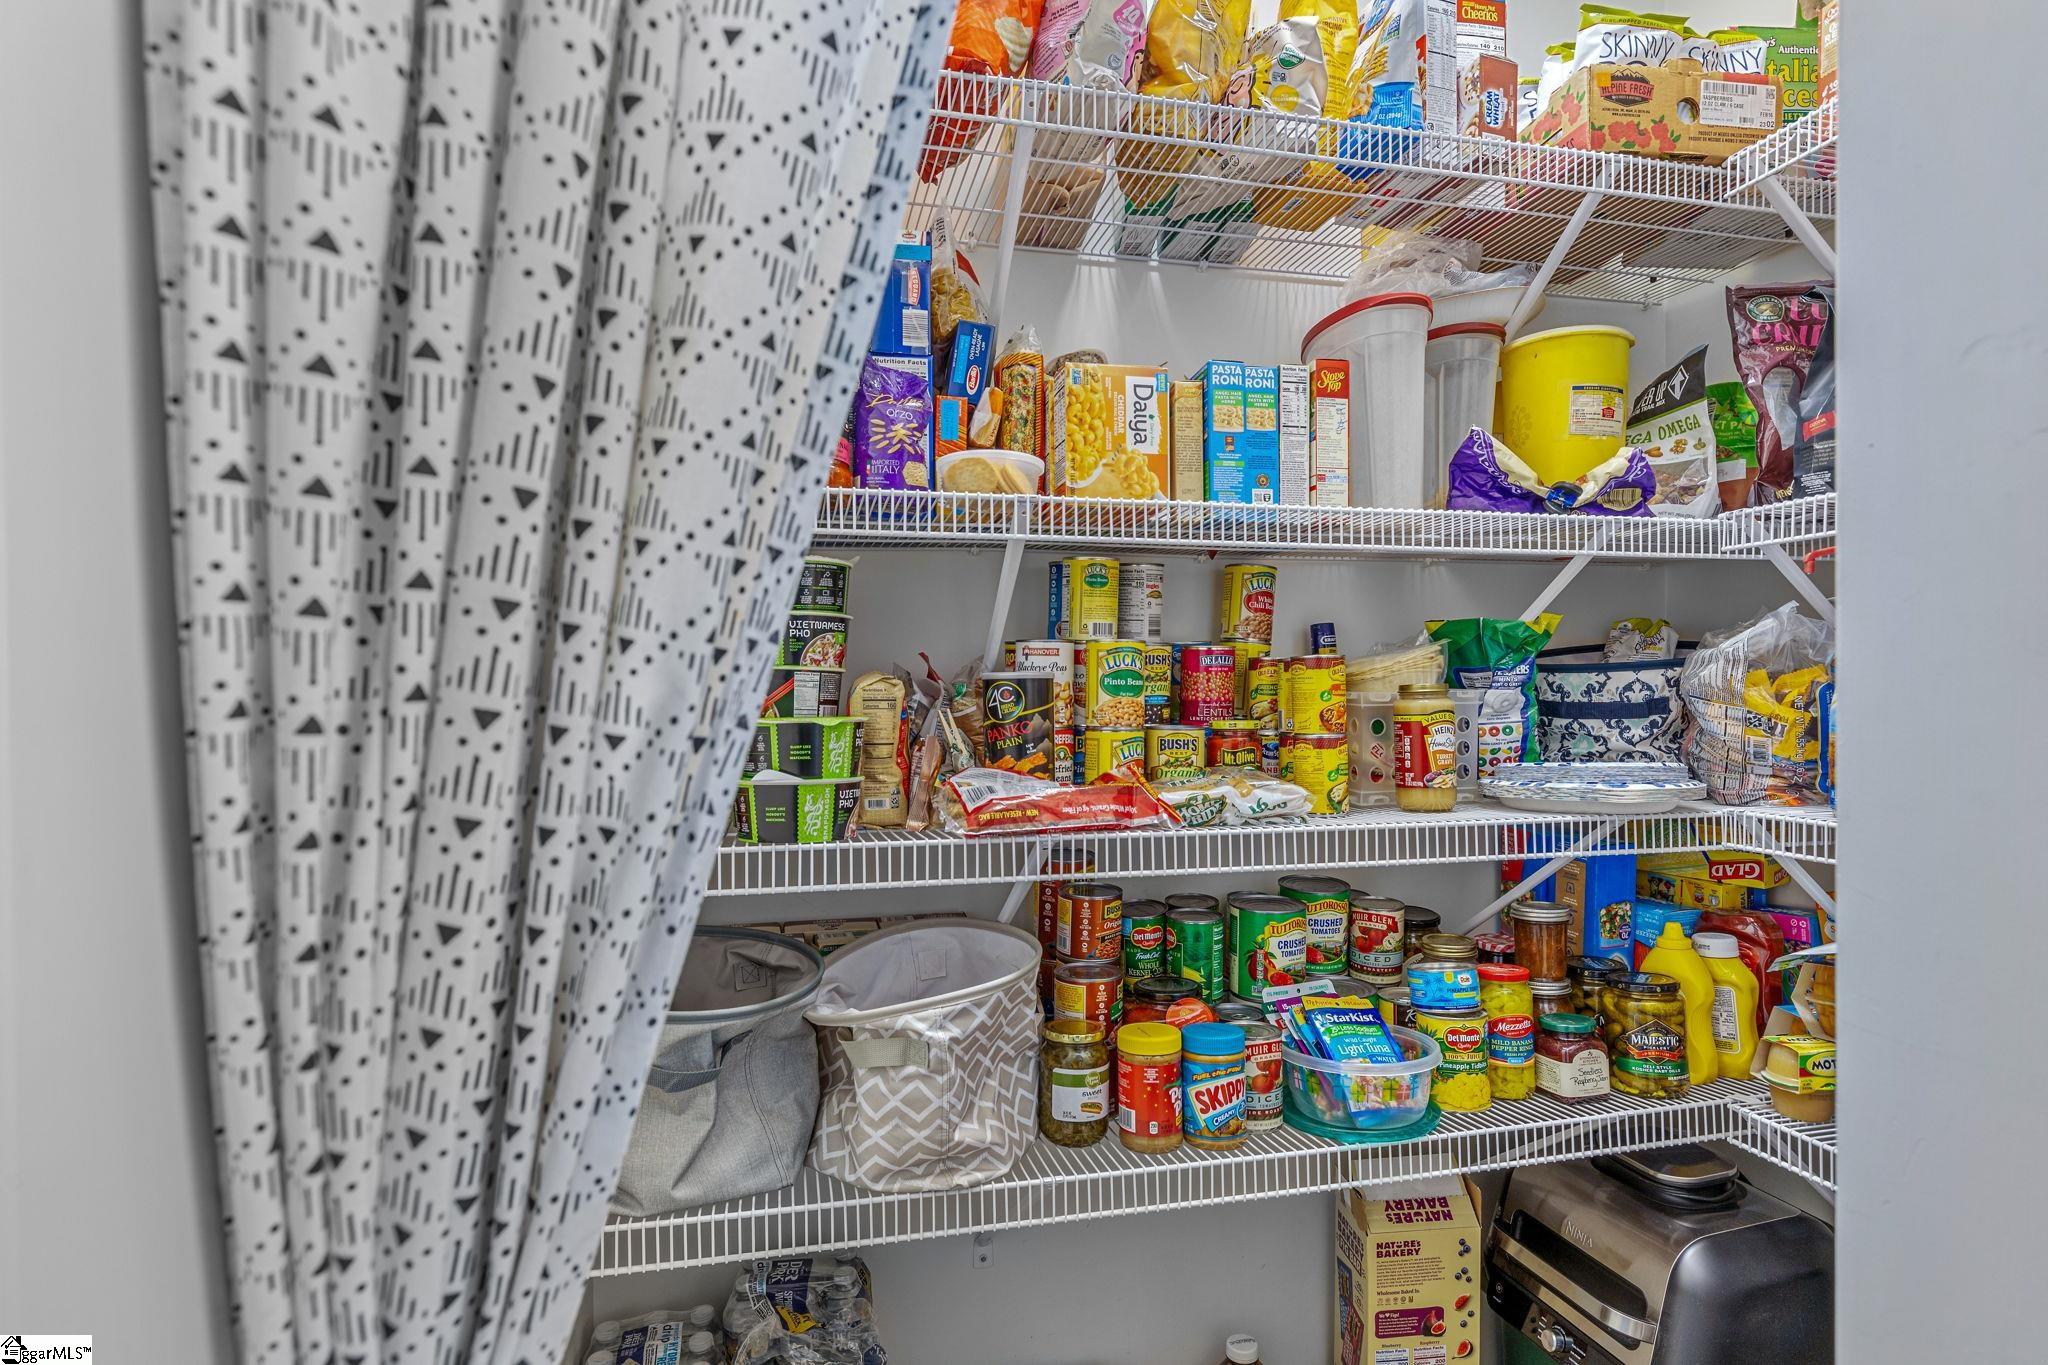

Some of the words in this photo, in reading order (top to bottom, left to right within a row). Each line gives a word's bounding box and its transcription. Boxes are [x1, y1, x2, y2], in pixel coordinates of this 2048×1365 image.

[1462, 7, 1498, 22] Cheerios
[1484, 91, 1493, 125] CREAM
[1492, 92, 1500, 125] WHEAT
[1212, 365, 1242, 375] PASTA
[1245, 369, 1274, 378] PASTA
[1212, 375, 1243, 385] RONI
[1245, 378, 1275, 389] RONI
[1317, 370, 1345, 387] Stove
[1327, 380, 1342, 393] Top
[1117, 394, 1125, 433] CHEDDAR
[1128, 384, 1154, 446] Daiya
[1658, 414, 1701, 440] OMEGA
[788, 620, 846, 631] VIETNAMESE
[789, 630, 811, 638] PHO
[1049, 662, 1068, 672] Peas
[1106, 653, 1144, 670] LUCK'S
[1104, 677, 1126, 686] Pinto
[1198, 703, 1233, 717] LENTILS
[1424, 713, 1447, 724] VALUE
[988, 721, 1033, 743] PANKO
[996, 735, 1023, 750] PLAIN
[1159, 738, 1198, 751] BUSH'S
[1224, 752, 1236, 765] Mt.
[1236, 751, 1255, 765] Olive
[839, 799, 853, 808] PHO
[1062, 806, 1077, 814] Fiber
[978, 812, 991, 821] BAG
[1711, 863, 1761, 879] GLAD
[1308, 918, 1343, 927] CRUSHED
[1352, 913, 1368, 921] MUIR
[1372, 915, 1393, 925] GLEN
[1133, 933, 1144, 941] Del
[1144, 932, 1162, 940] Monte
[1278, 936, 1306, 950] CRUSHED
[1281, 947, 1306, 958] TOMATOES
[1351, 952, 1392, 963] DICED
[1128, 968, 1152, 976] KERNEL
[1325, 1012, 1375, 1023] StarKist
[1494, 1020, 1532, 1032] Mezzetta
[1447, 1034, 1458, 1042] Del
[1460, 1034, 1480, 1042] Monte
[1631, 1035, 1679, 1047] MAJESTIC
[1246, 1044, 1269, 1056] MUIR
[1338, 1044, 1363, 1056] Light
[1365, 1043, 1390, 1053] Tuna
[1377, 1055, 1397, 1063] WATER
[1439, 1062, 1470, 1072] Pineapple
[1471, 1062, 1487, 1070] Tidbits
[1193, 1073, 1211, 1081] FUEL
[1578, 1069, 1603, 1077] Seedless
[1213, 1108, 1236, 1126] CREAMY
[1384, 1197, 1450, 1212] BAKERY
[1387, 1210, 1454, 1224] NATURE'S
[1566, 1221, 1593, 1248] NINJA
[1376, 1240, 1421, 1250] NATURE'S
[1376, 1248, 1421, 1259] BAKERY
